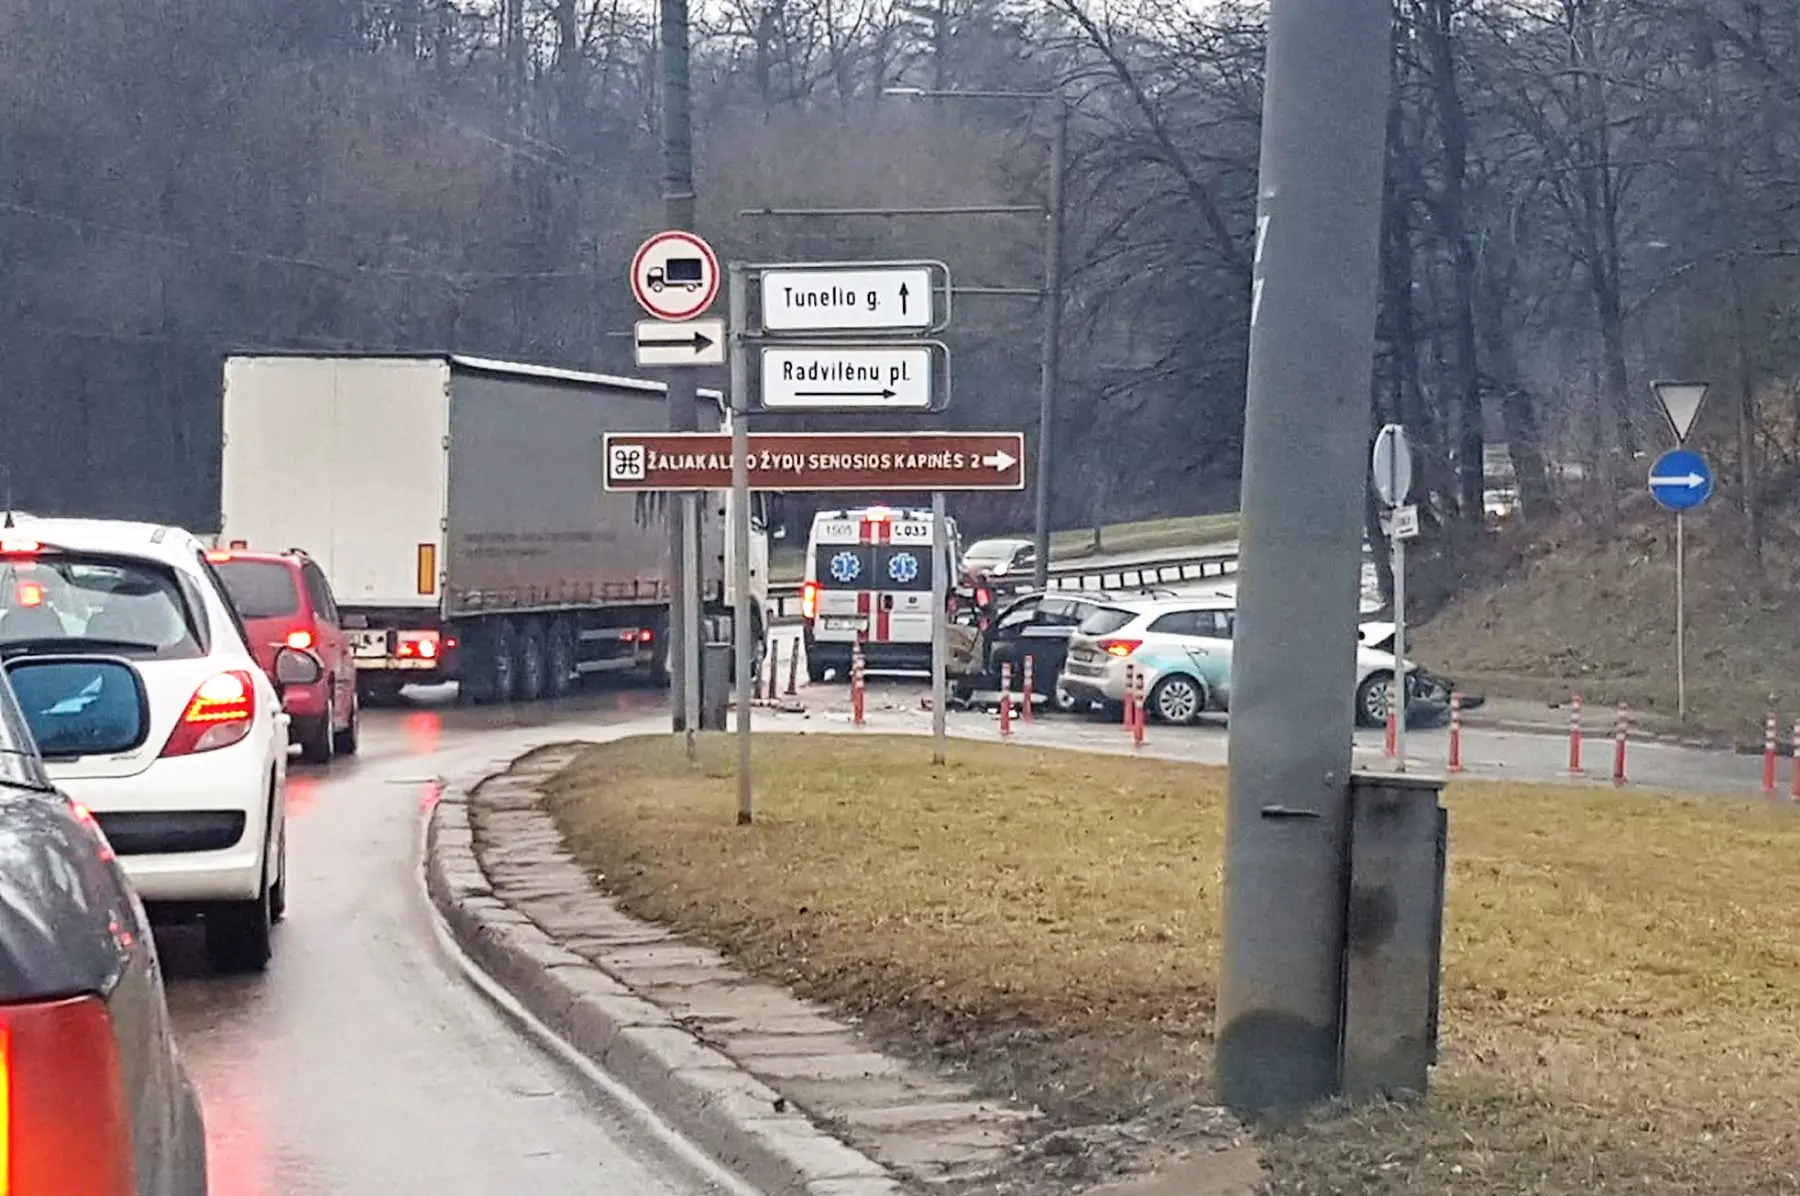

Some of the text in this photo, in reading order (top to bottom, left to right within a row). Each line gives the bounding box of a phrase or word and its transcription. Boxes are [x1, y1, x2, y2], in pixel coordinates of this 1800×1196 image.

[784, 286, 856, 308] Tunelio
[760, 449, 804, 474] ŽYDŲ
[808, 453, 890, 469] SENOSIOS
[893, 450, 964, 469] KAPINĖS
[970, 453, 980, 469] 2
